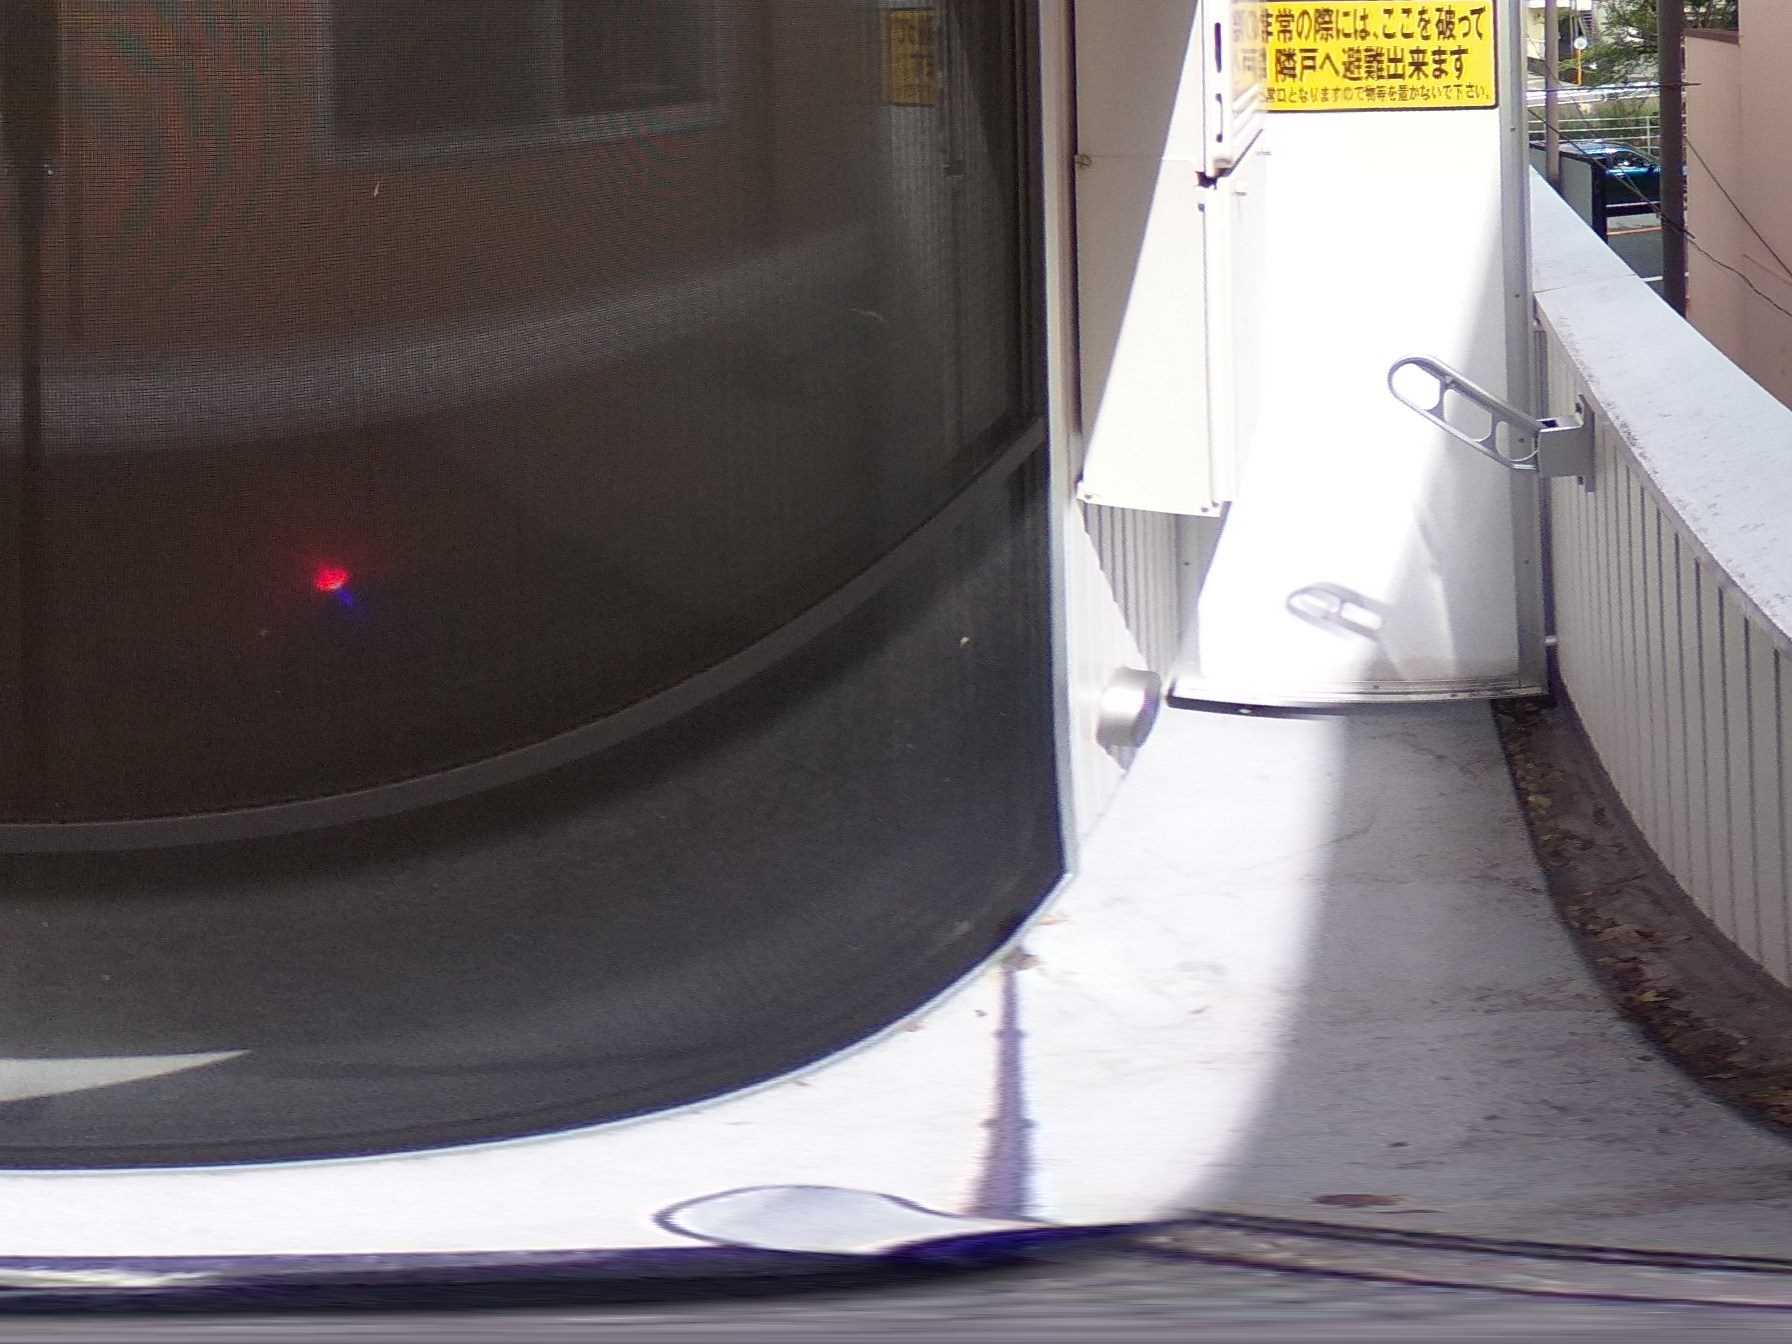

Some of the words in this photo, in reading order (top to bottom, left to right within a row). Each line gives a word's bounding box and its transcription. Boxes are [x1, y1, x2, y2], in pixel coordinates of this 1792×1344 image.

[1275, 45, 1469, 83] 隣戸へ避難出来ます
[1259, 83, 1490, 104] 常口となりますので物等を置かないで下さい。
